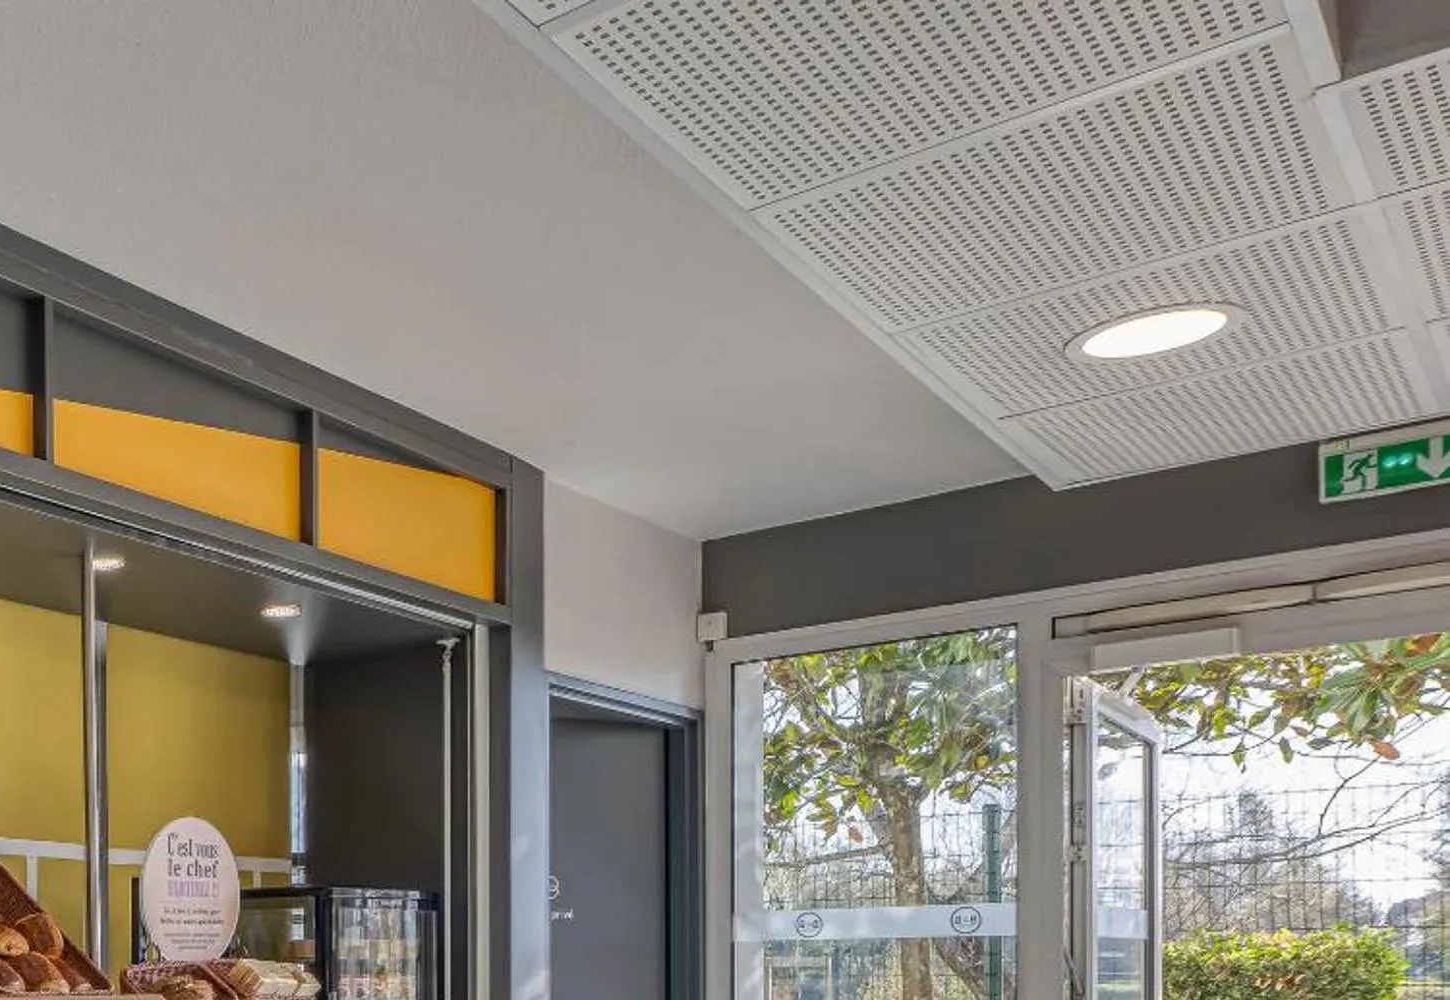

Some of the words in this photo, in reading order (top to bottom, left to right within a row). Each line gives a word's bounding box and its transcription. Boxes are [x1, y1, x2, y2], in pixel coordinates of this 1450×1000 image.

[167, 832, 193, 857] C'est
[167, 858, 181, 877] le
[186, 859, 219, 878] chef
